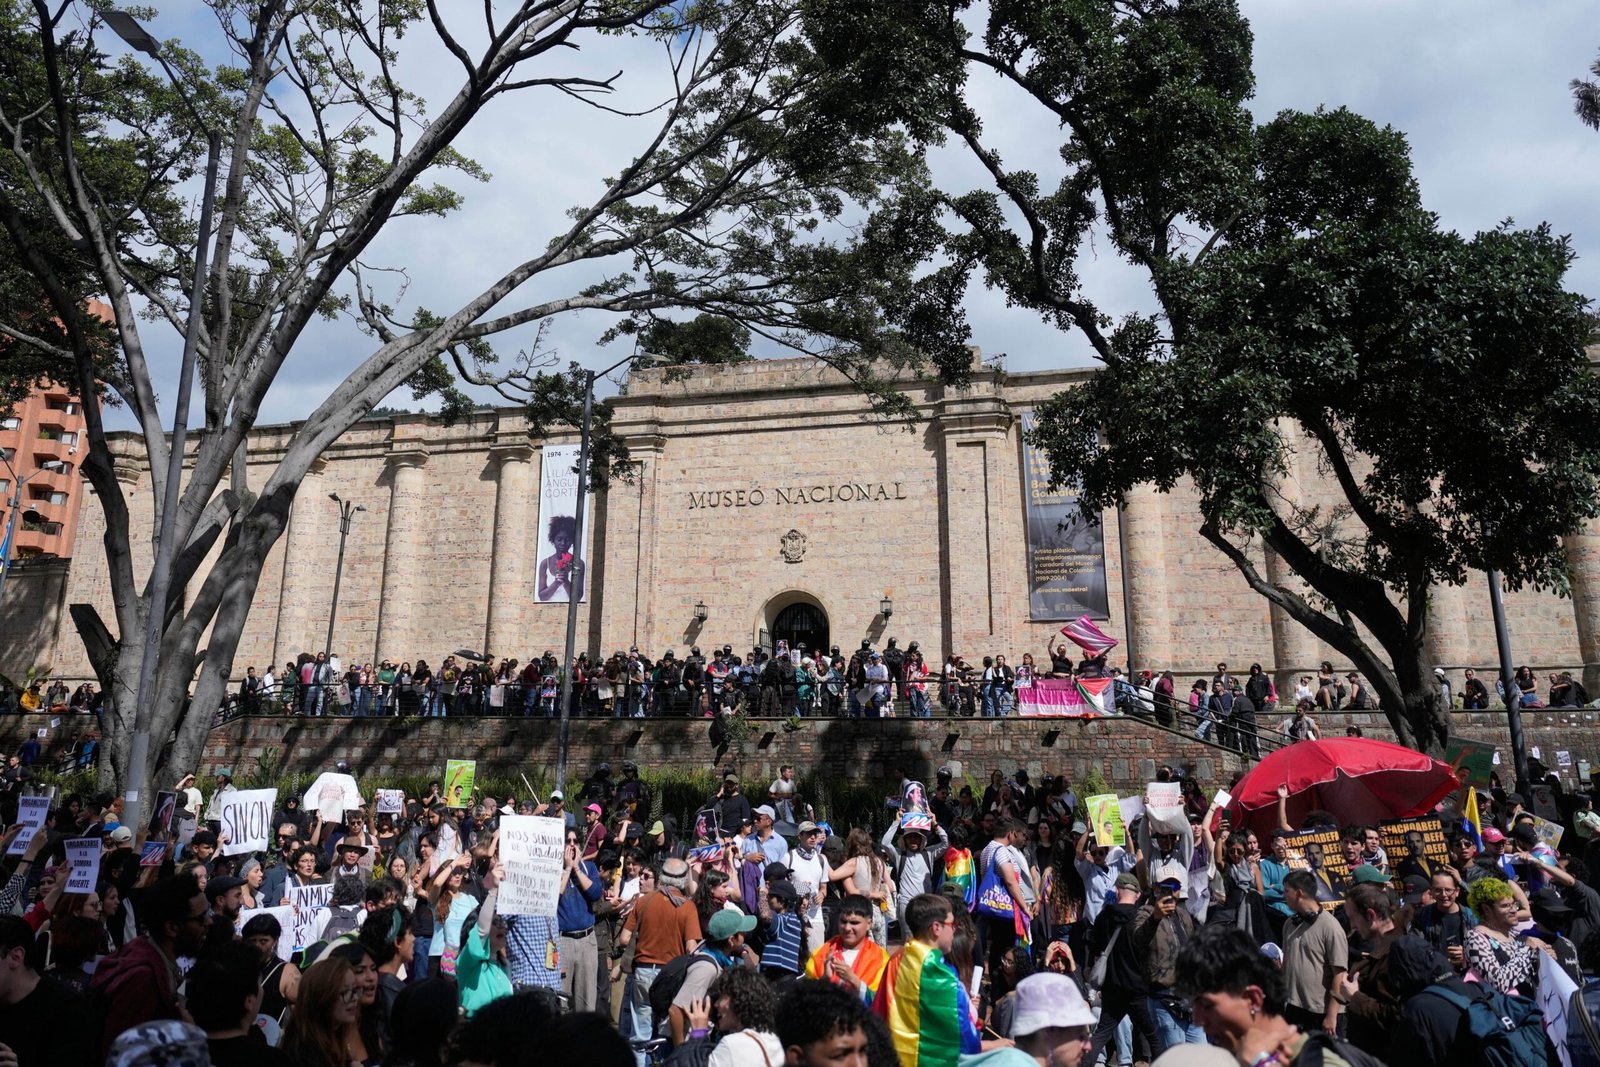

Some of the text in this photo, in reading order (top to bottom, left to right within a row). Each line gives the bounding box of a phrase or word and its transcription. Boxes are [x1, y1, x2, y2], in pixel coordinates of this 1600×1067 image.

[689, 482, 908, 510] MUSEO NACIONAL
[507, 830, 529, 843] NOS
[12, 841, 30, 849] MUERT
[68, 880, 90, 888] MUERTE
